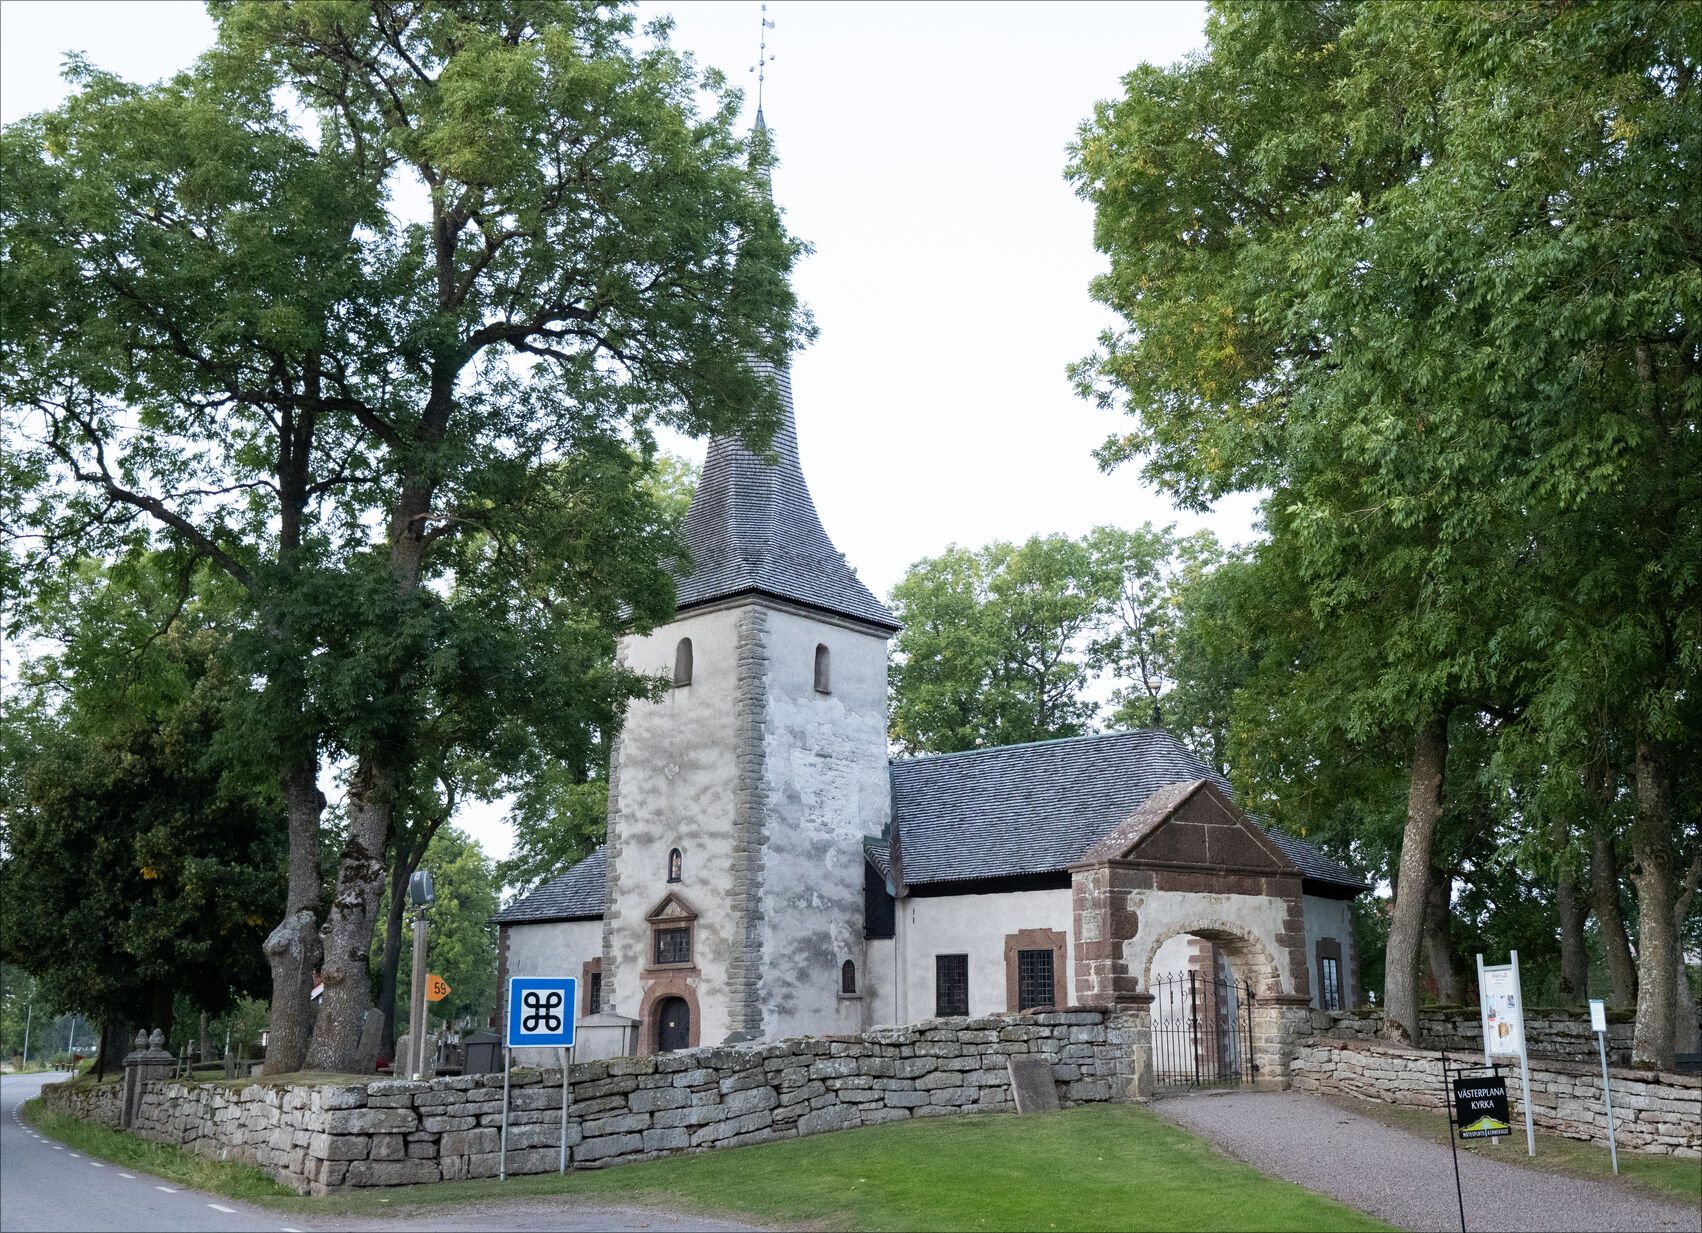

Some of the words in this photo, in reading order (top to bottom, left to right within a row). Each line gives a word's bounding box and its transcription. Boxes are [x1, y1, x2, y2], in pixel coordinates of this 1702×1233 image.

[434, 982, 446, 994] 59
[1457, 1087, 1505, 1099] VÄSTERPLANA
[1471, 1100, 1494, 1109] KYRKA
